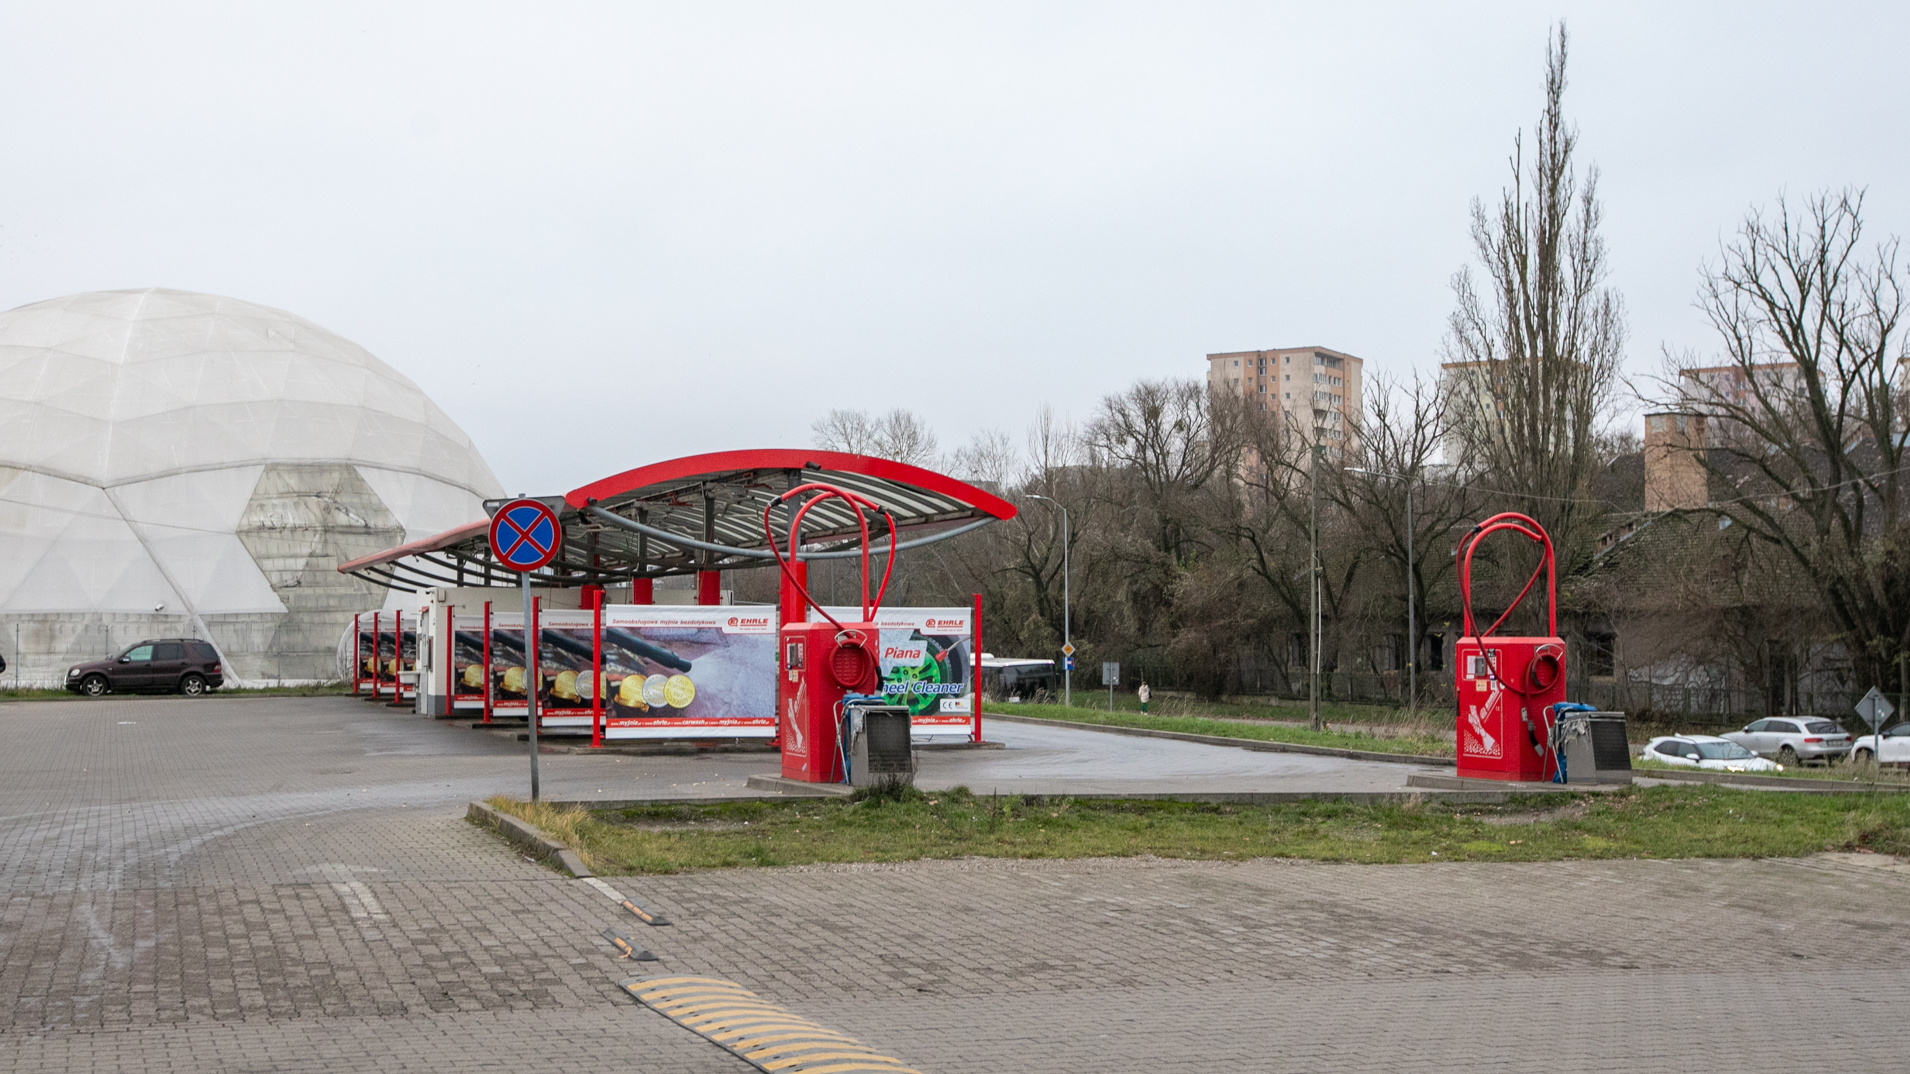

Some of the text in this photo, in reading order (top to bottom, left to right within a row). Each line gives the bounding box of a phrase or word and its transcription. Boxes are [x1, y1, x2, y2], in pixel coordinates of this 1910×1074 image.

[884, 647, 921, 659] Piana
[882, 680, 964, 693] heel Cleaner
